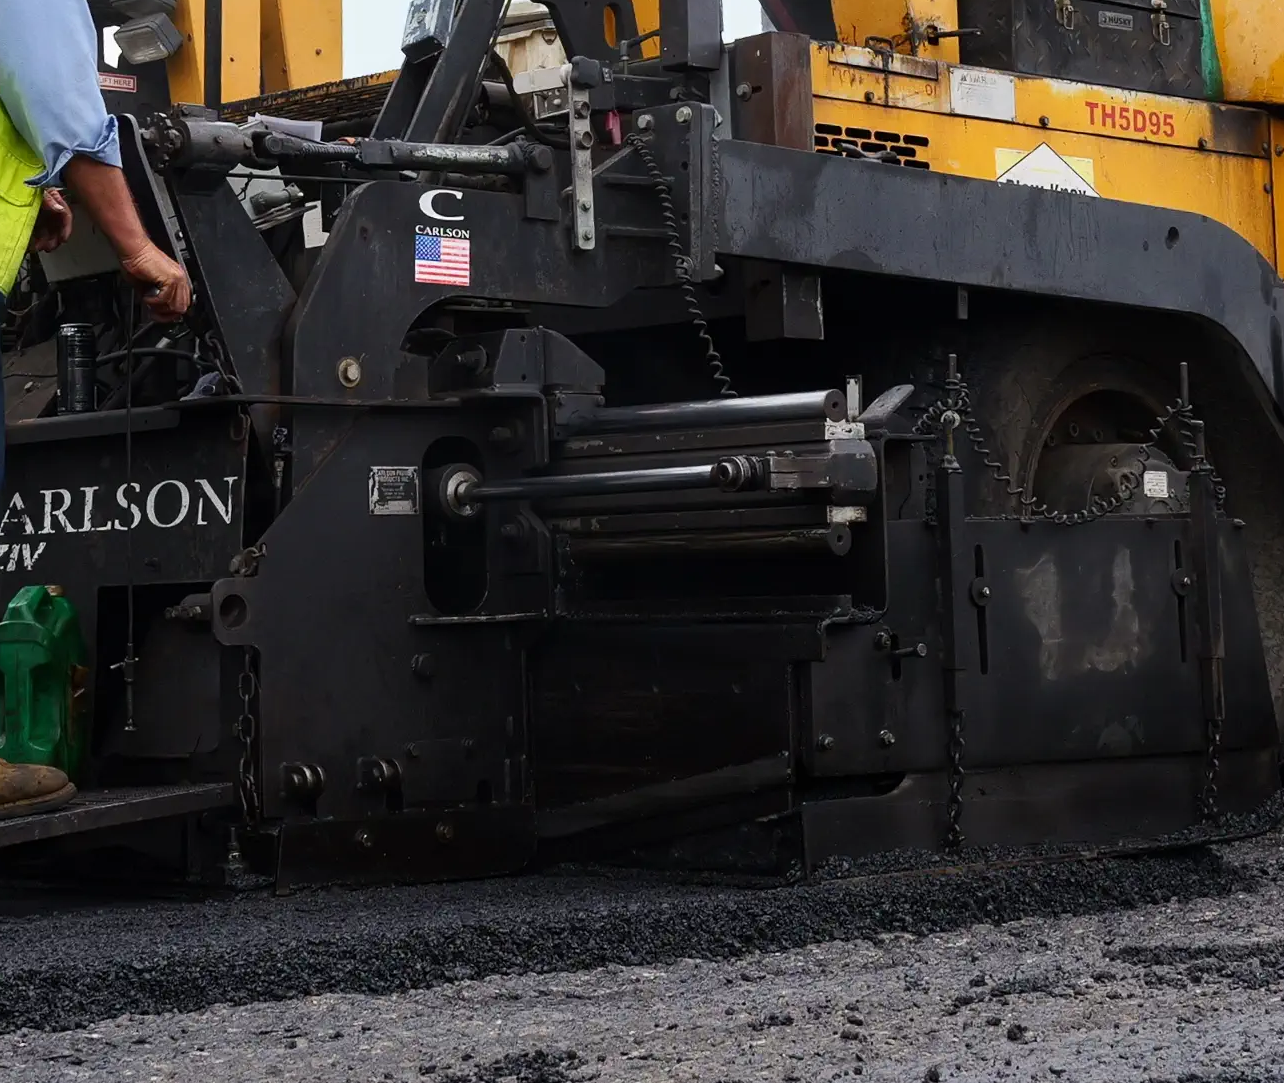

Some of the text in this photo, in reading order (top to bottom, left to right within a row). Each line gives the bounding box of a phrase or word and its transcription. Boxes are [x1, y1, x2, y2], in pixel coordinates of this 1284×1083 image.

[113, 79, 132, 87] HERE
[1085, 100, 1175, 138] TH5D95
[419, 189, 465, 221] C
[415, 224, 470, 239] CARLSON
